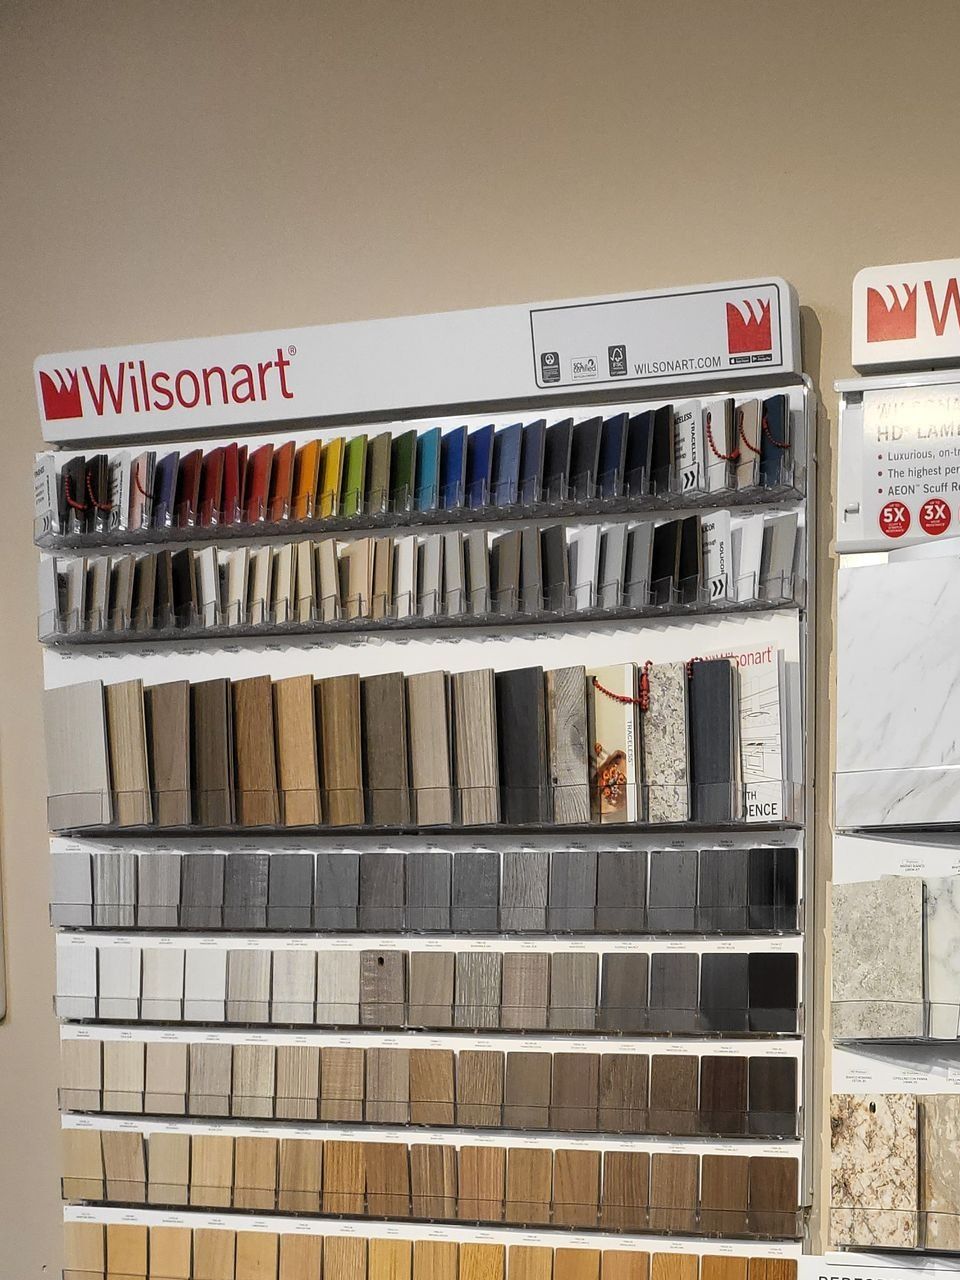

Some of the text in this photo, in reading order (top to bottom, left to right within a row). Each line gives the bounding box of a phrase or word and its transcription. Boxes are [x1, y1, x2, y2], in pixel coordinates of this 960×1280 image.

[634, 355, 722, 375] WILSONART.COM
[888, 450, 936, 462] Luxurious,
[888, 467, 905, 479] The
[907, 463, 942, 479] highest
[923, 481, 948, 494] Scuff
[883, 507, 905, 523] 5X
[924, 504, 947, 520] 3X
